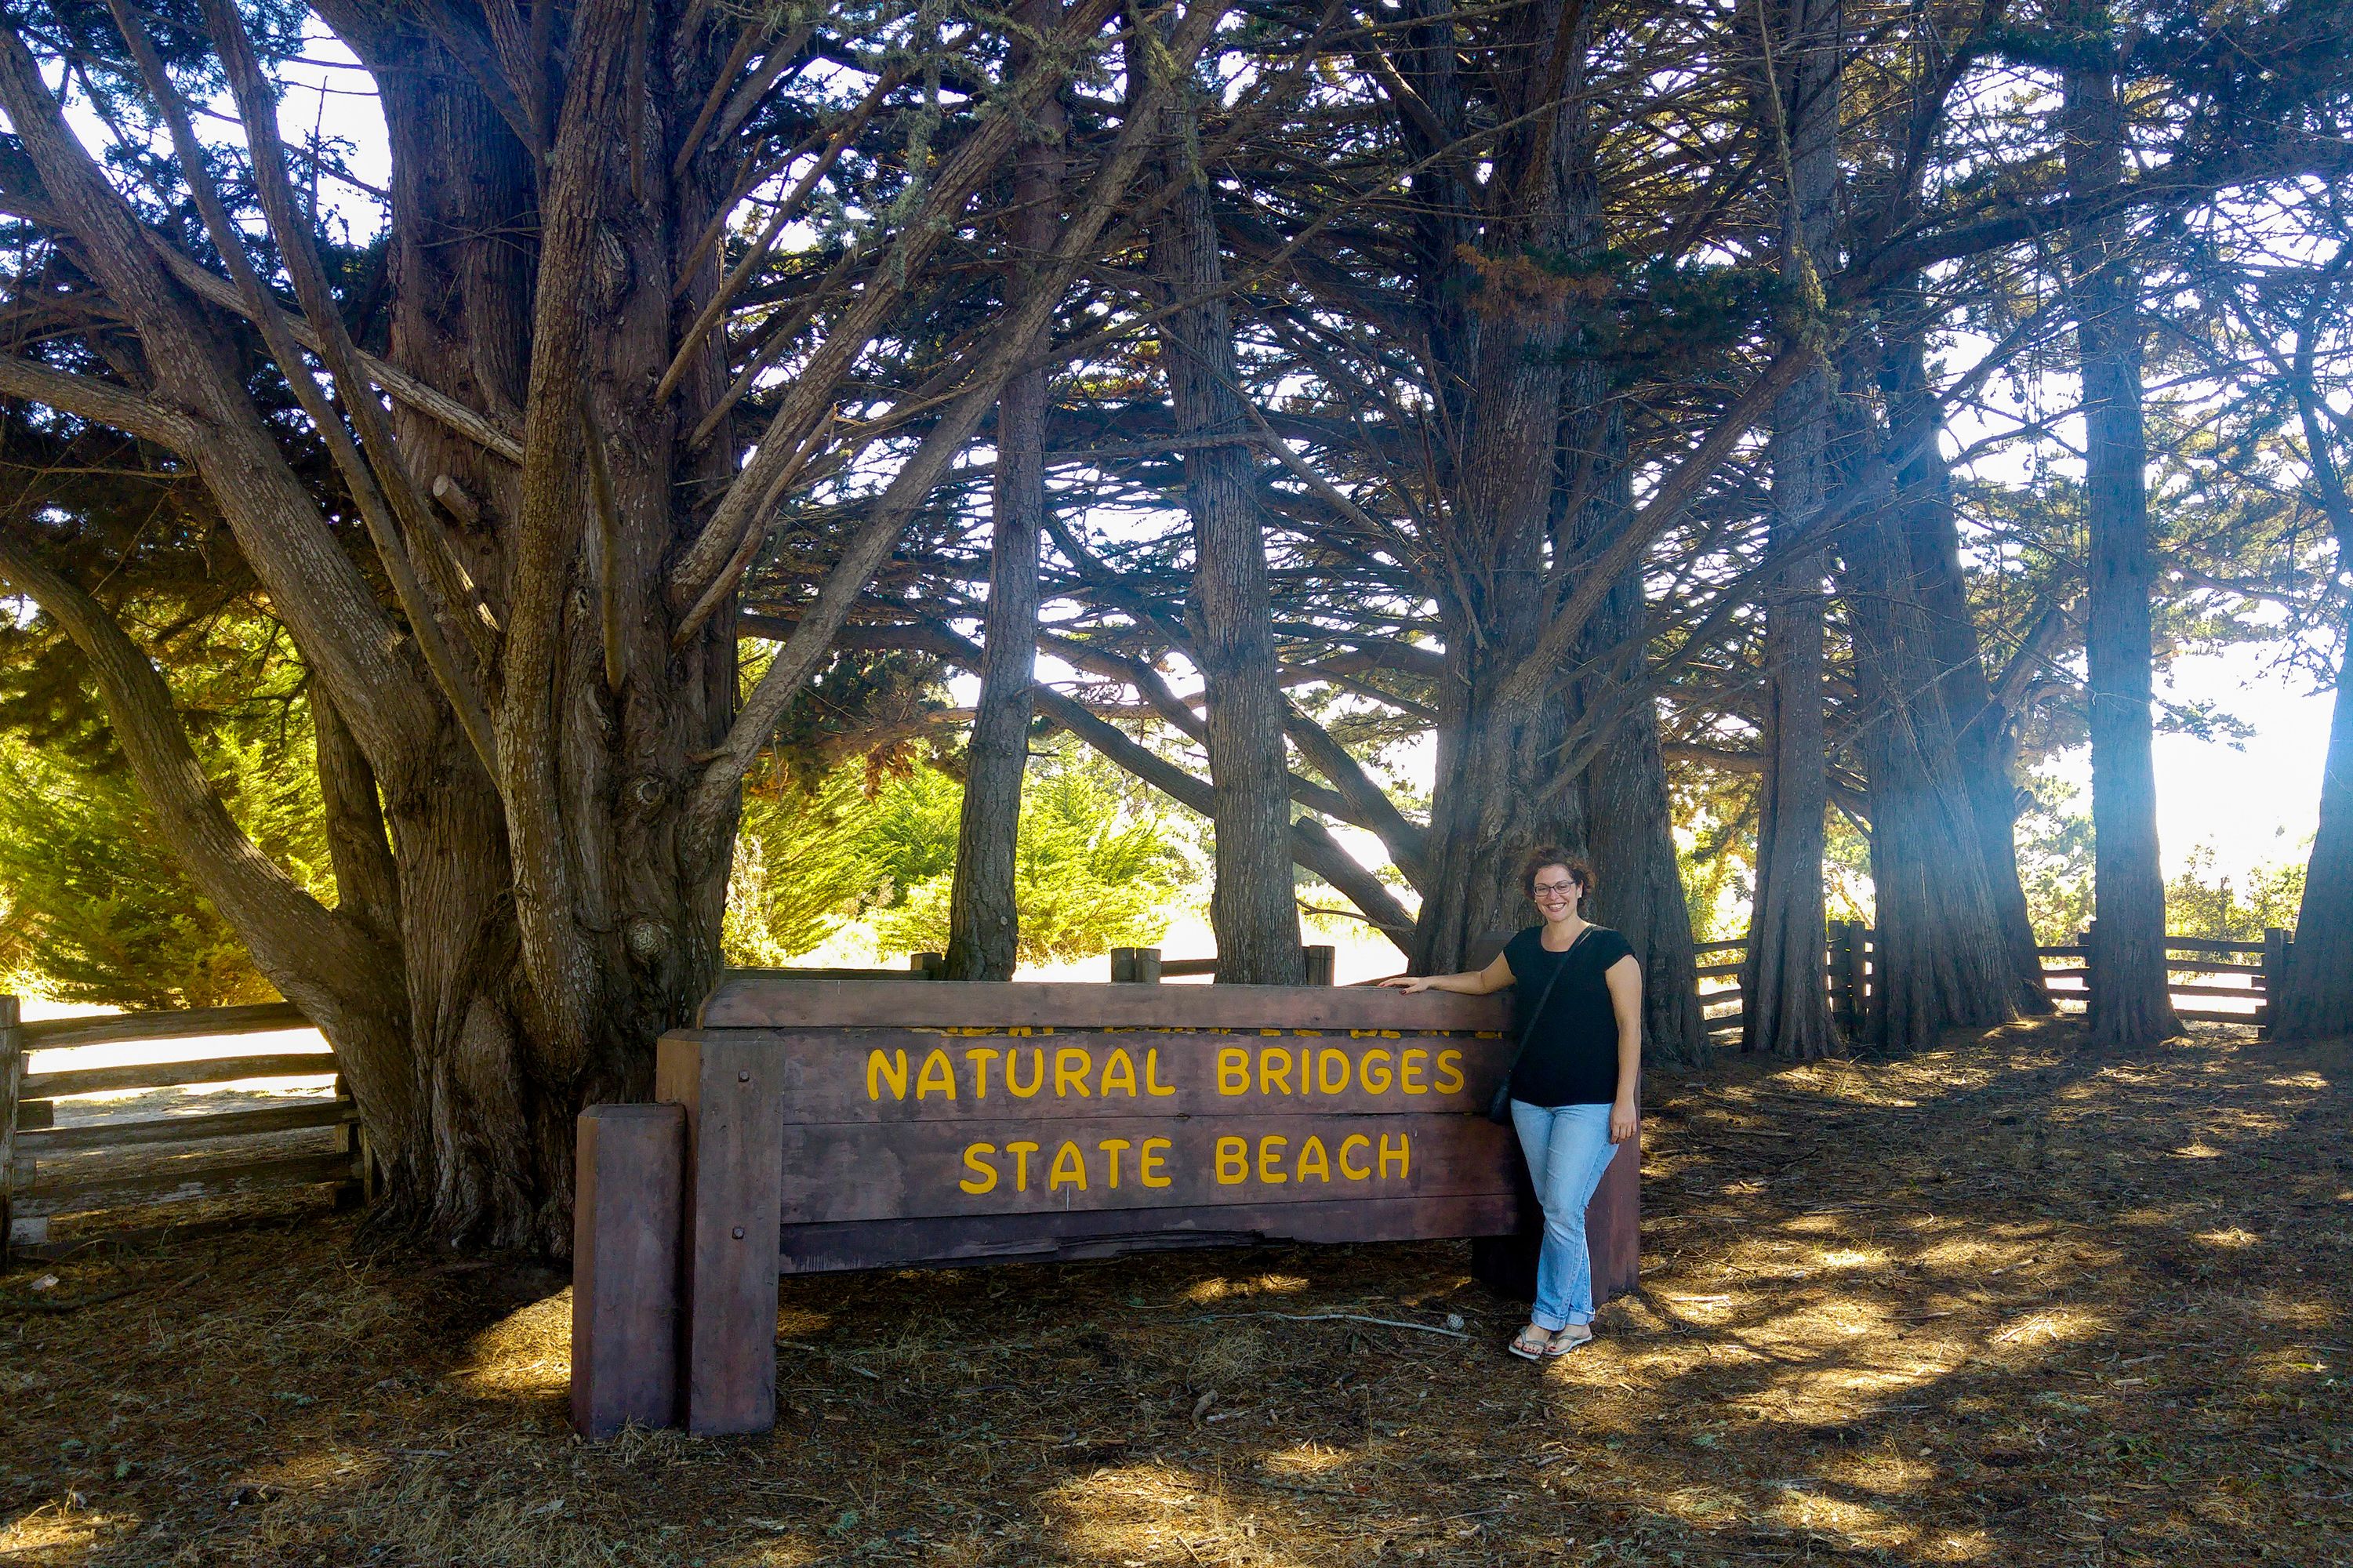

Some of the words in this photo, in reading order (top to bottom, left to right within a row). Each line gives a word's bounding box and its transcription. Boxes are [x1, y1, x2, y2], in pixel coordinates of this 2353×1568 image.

[866, 1047, 1177, 1102] NATURAL
[1216, 1047, 1465, 1097] BRIDGES
[959, 1137, 1172, 1195] STATE
[1214, 1132, 1411, 1185] BEACH
